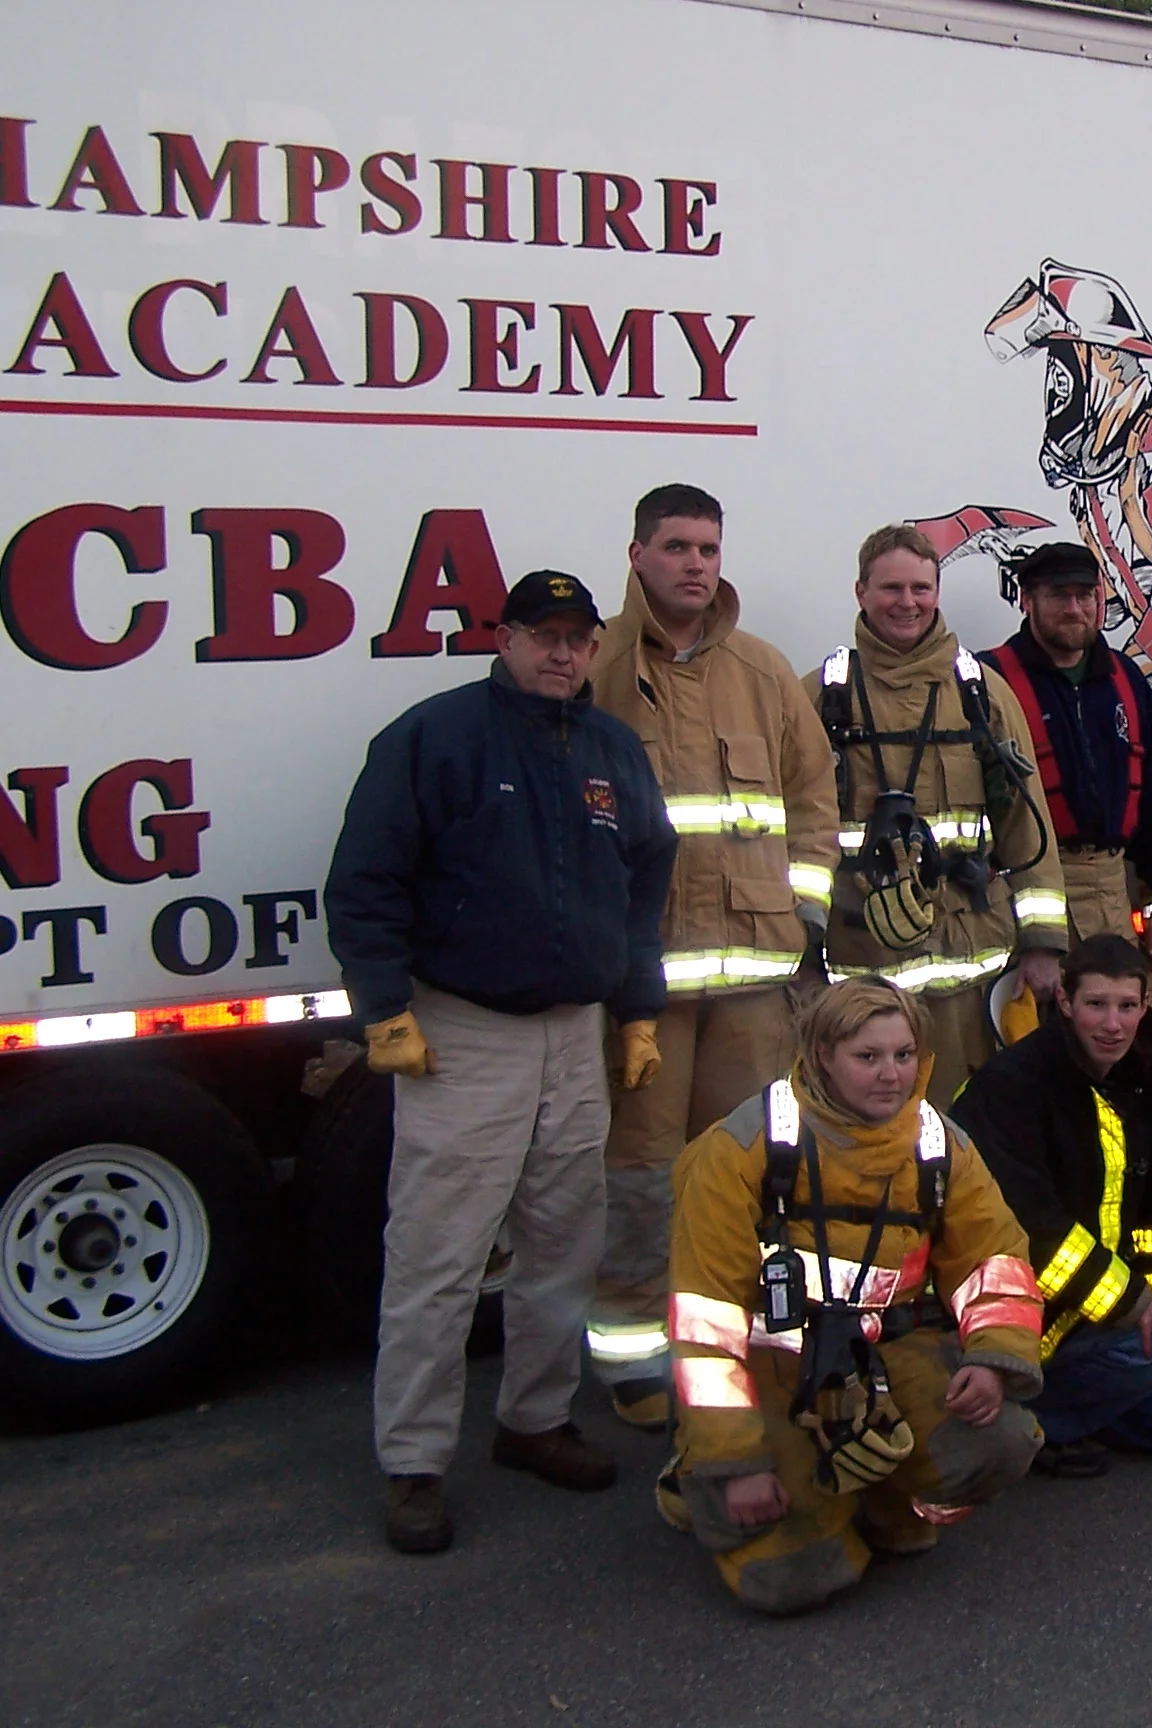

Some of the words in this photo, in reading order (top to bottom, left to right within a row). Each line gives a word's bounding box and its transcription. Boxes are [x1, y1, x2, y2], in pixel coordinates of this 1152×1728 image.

[2, 271, 756, 402] ACADEMY
[0, 502, 507, 671] CBA
[0, 904, 108, 988] T
[151, 890, 318, 977] OF
